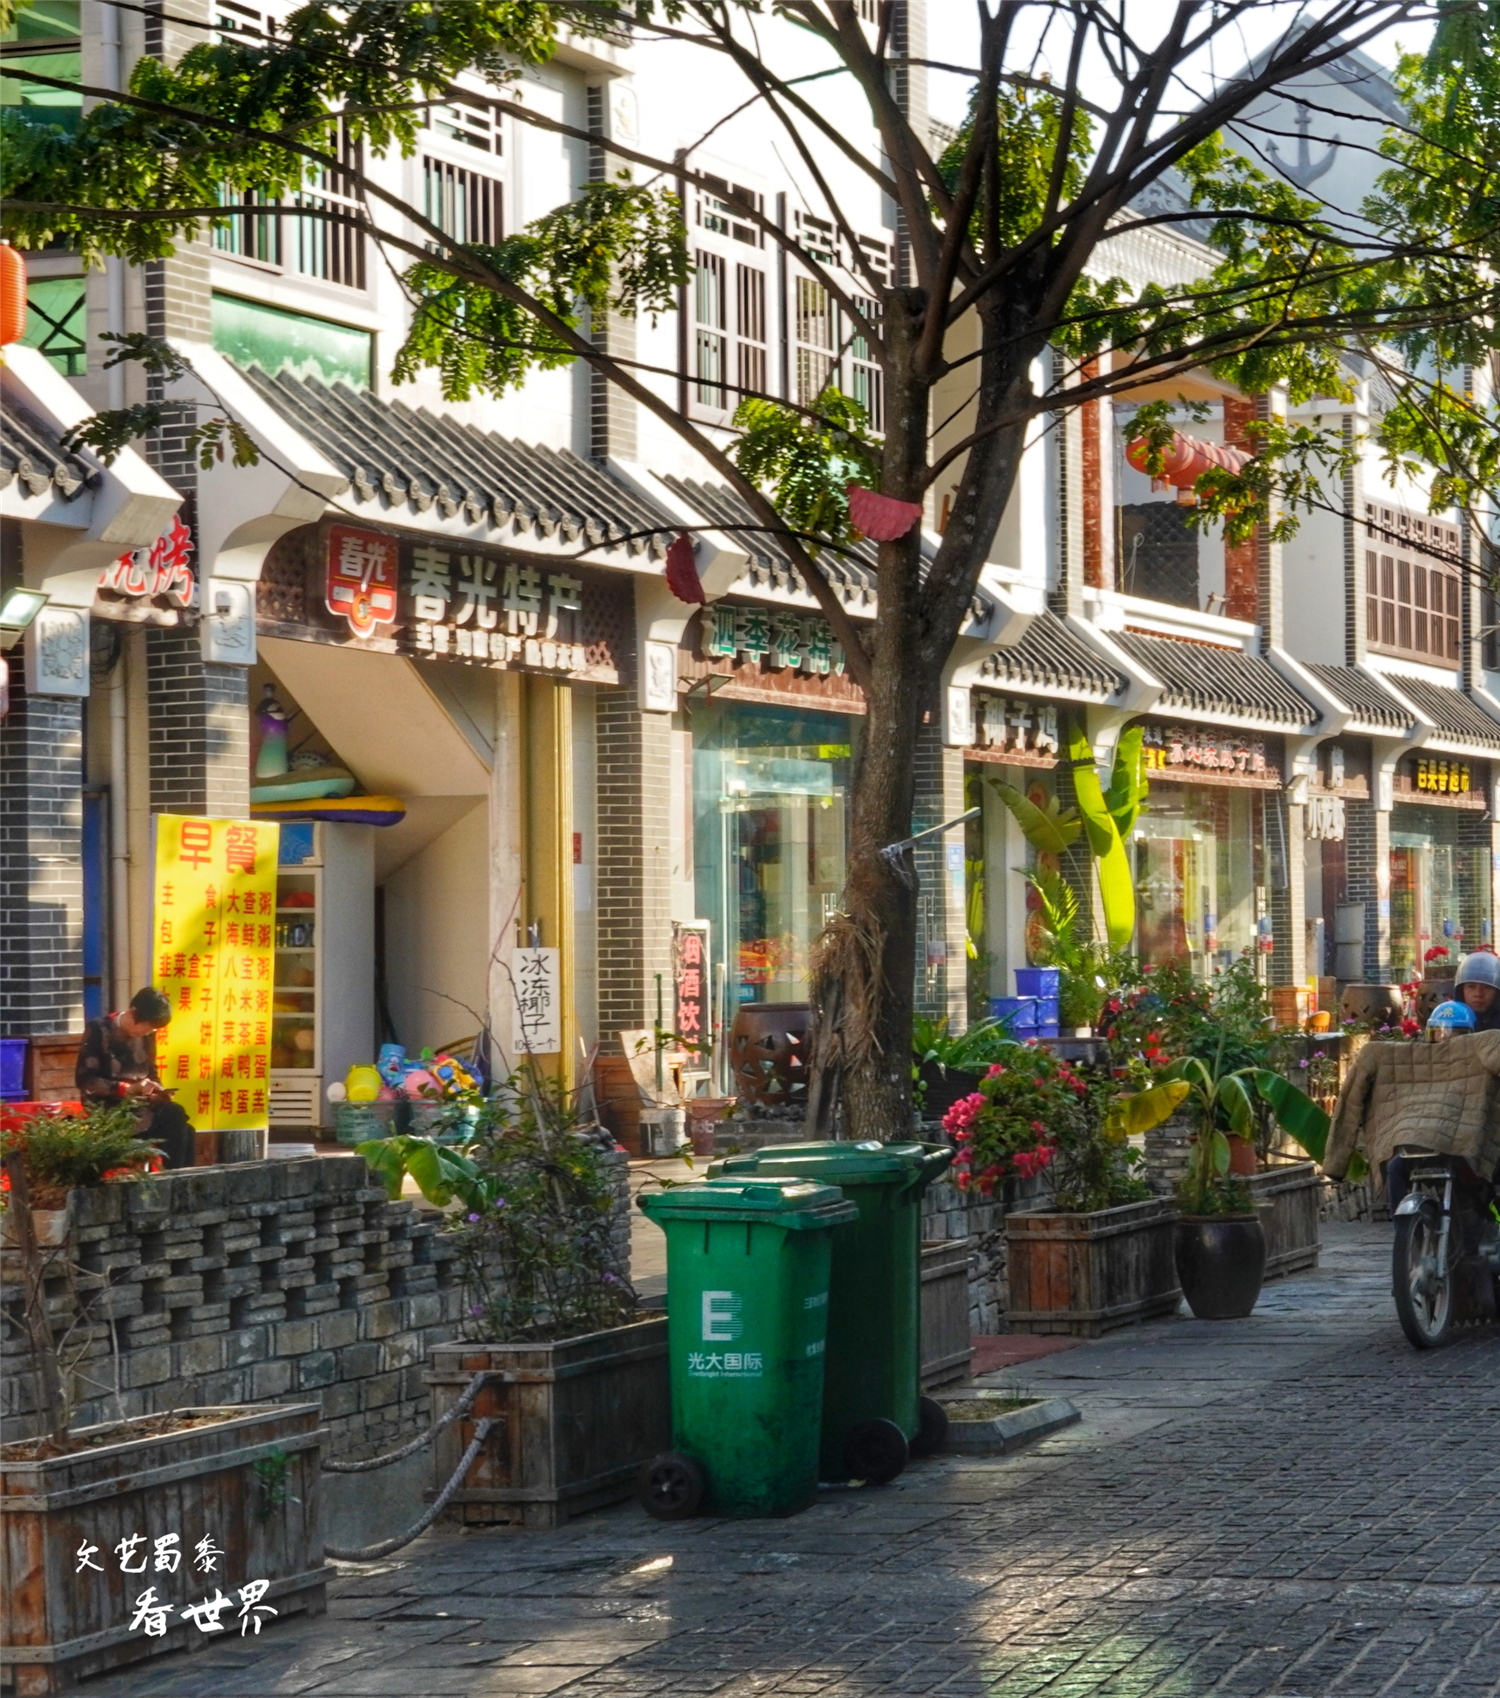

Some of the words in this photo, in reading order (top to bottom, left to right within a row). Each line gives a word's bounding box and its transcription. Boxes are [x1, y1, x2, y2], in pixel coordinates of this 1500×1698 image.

[338, 535, 389, 592] 春光
[410, 546, 584, 639] 春光特产
[179, 821, 257, 875] 早餐
[161, 919, 217, 946] 包子
[226, 921, 271, 949] 海鲜粥
[158, 953, 215, 979] 韭菜盒子
[224, 955, 270, 981] 八宝粥
[223, 987, 269, 1013] 小米粥
[520, 953, 552, 1036] 冰冻椰子
[687, 1352, 764, 1370] 光大国际
